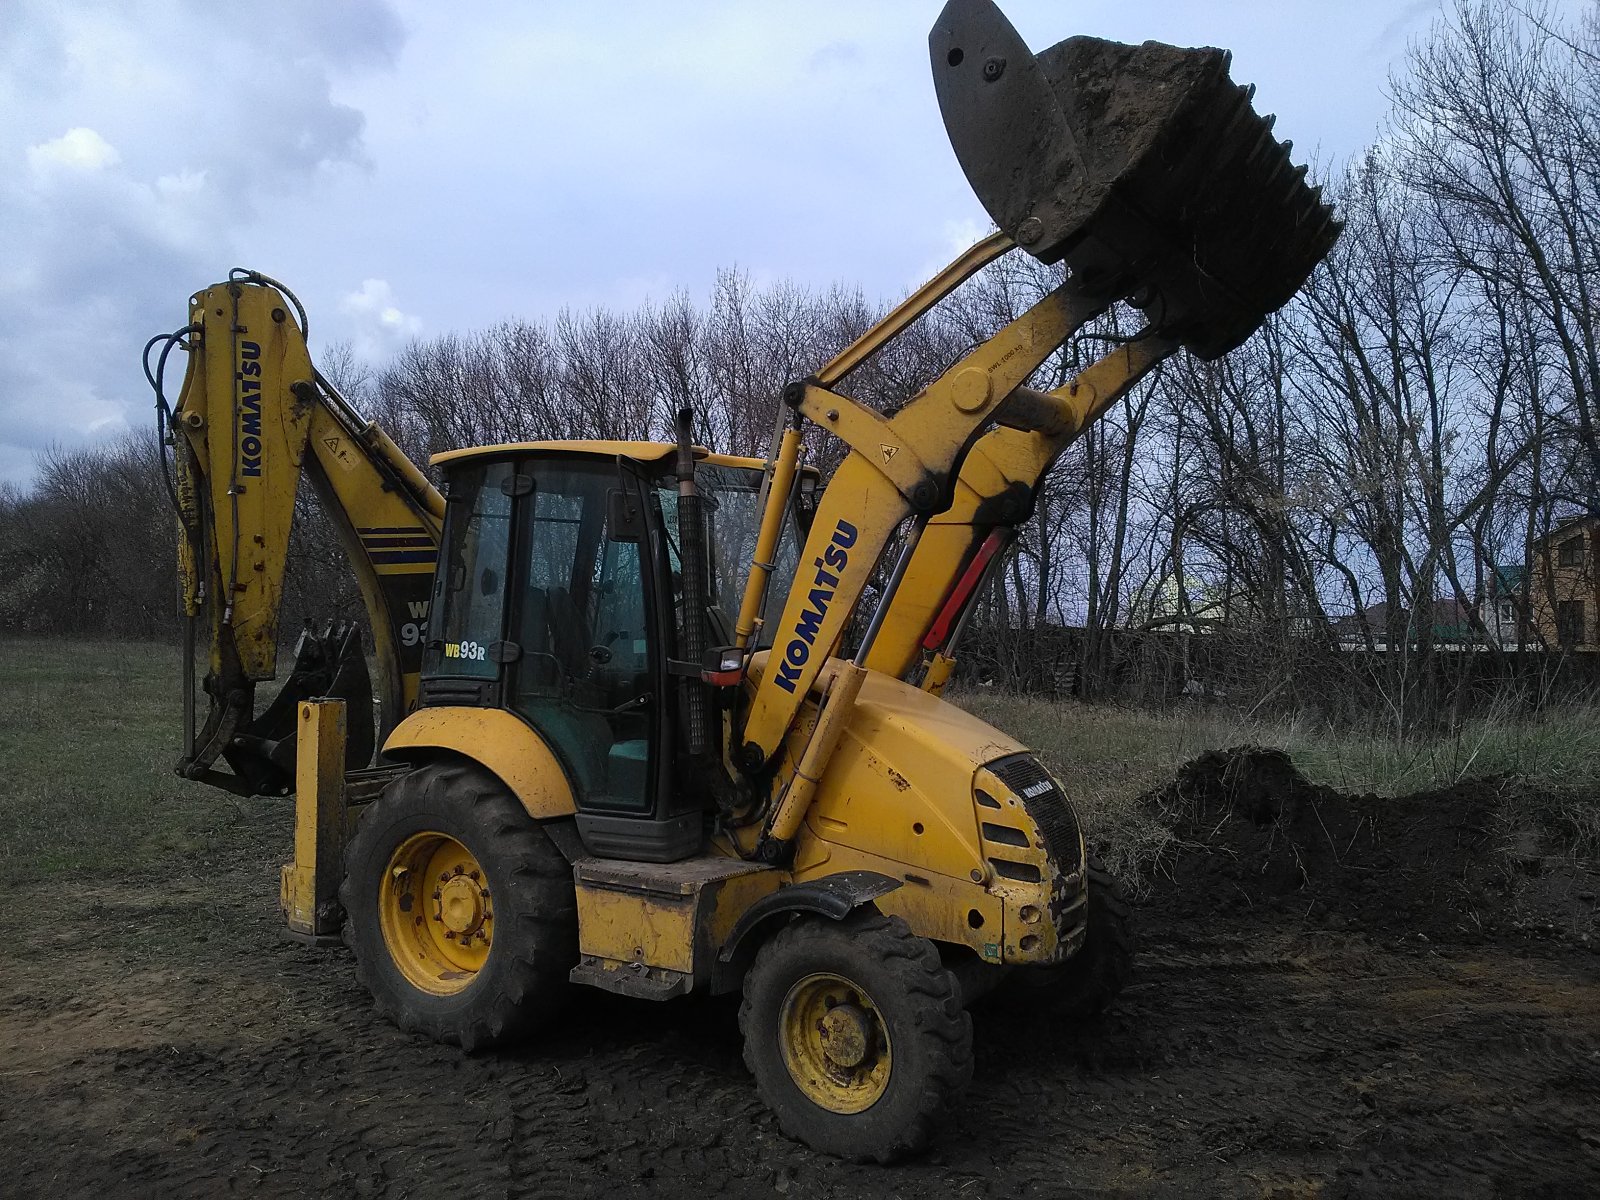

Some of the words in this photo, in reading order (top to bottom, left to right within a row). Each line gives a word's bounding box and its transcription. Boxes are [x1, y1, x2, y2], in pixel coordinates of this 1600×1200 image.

[237, 340, 262, 476] KOMATSU
[988, 361, 1001, 374] SWL
[774, 519, 858, 694] KOMATSU
